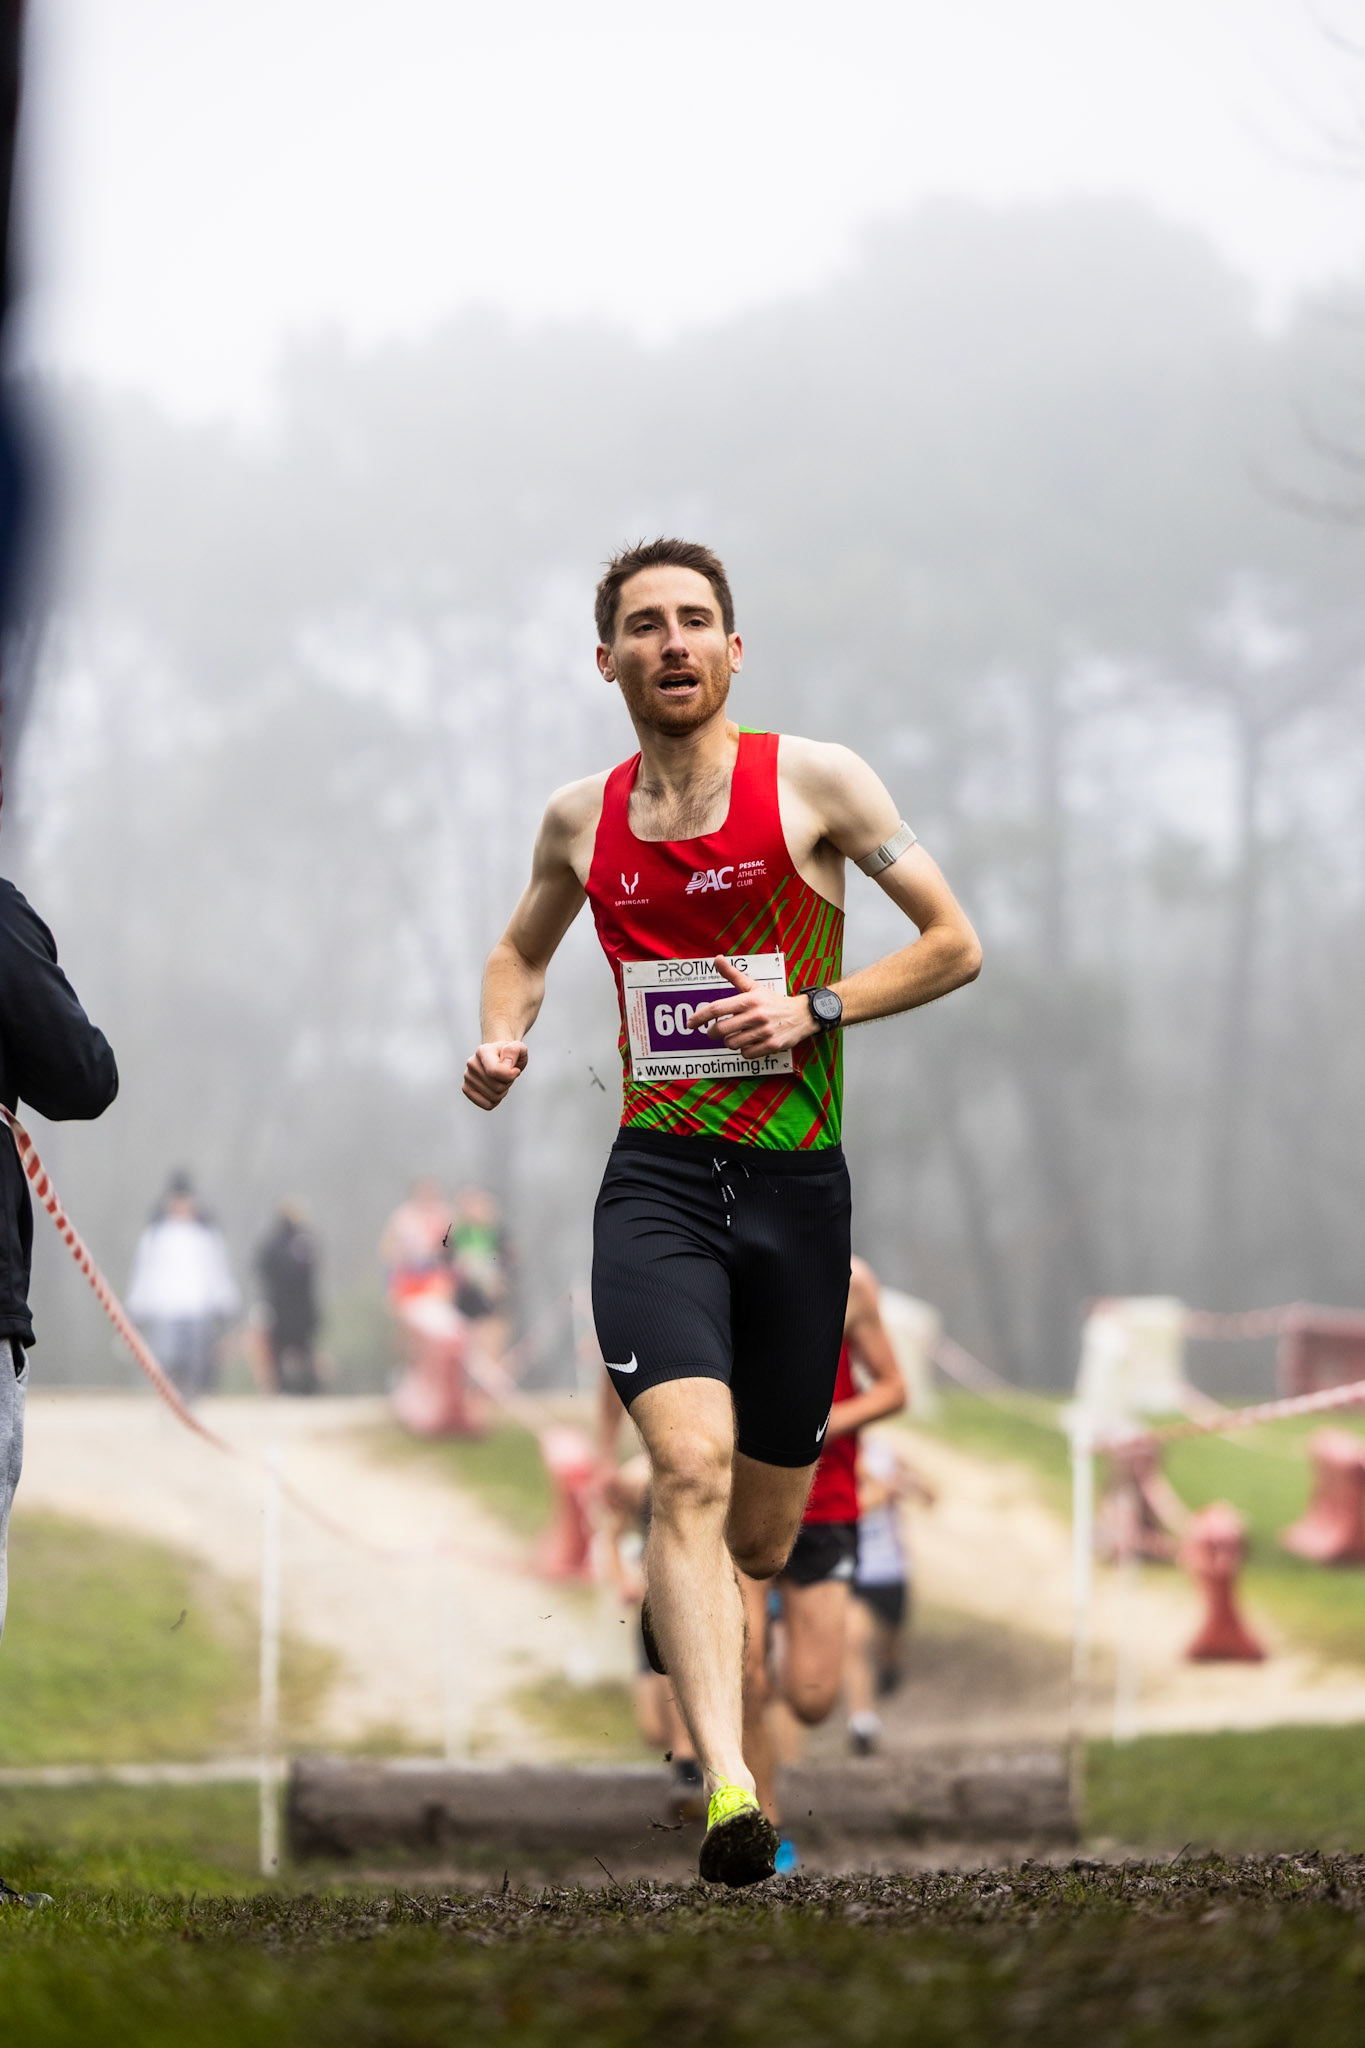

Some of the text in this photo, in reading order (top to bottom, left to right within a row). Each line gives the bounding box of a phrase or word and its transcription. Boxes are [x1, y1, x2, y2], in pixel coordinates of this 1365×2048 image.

[739, 860, 765, 869] PESSAC
[737, 868, 767, 878] ATHLETIC
[684, 866, 735, 894] PAC
[736, 879, 753, 887] CLUB
[615, 898, 650, 906] SPRINGART
[657, 958, 748, 978] PROTIMG
[645, 1056, 779, 1078] www.protiming.fr
